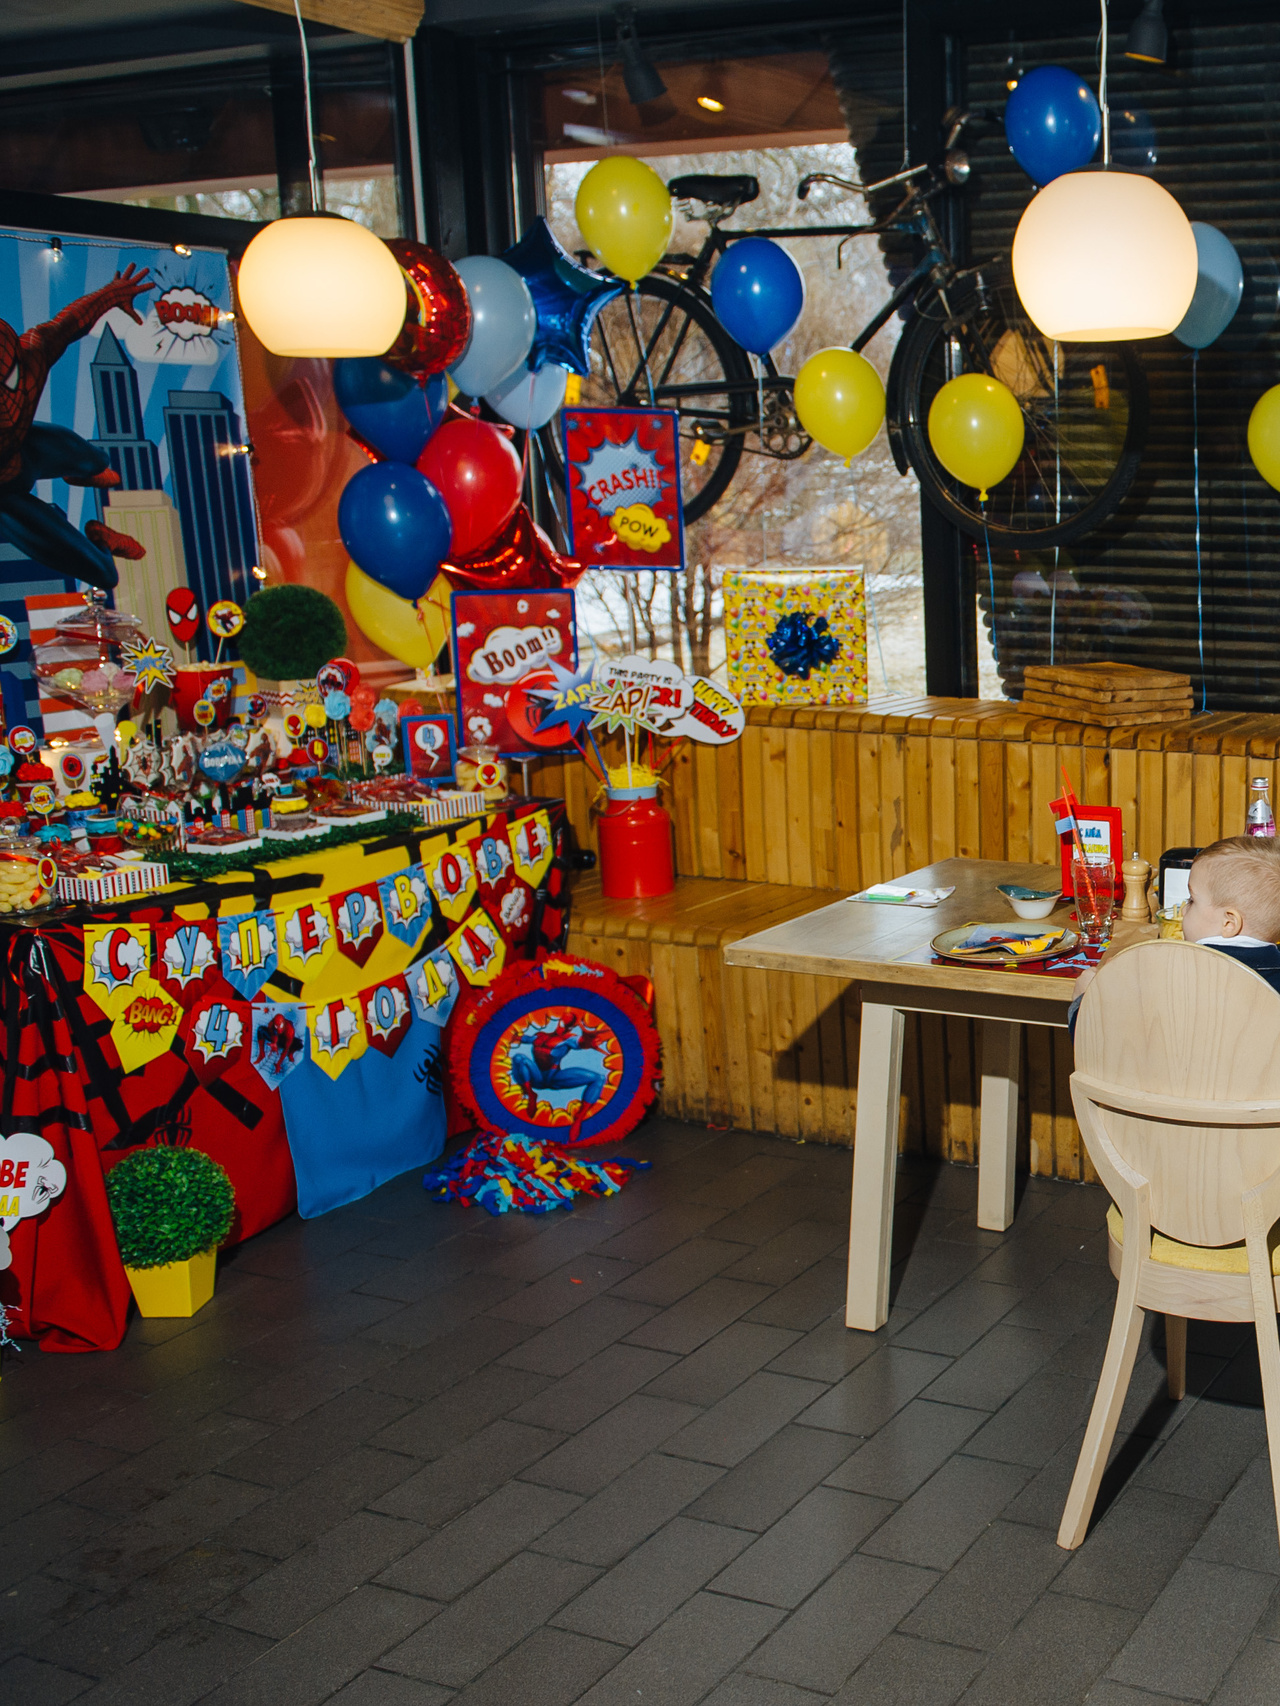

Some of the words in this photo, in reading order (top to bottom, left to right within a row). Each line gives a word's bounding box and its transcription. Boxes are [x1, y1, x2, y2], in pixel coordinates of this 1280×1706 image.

[587, 467, 662, 506] CRASH!!
[619, 516, 659, 538] POW
[609, 667, 628, 678] THIS
[631, 671, 662, 683] PARTY
[664, 676, 673, 685] IS
[592, 685, 650, 718] ZAP!
[692, 678, 739, 716] HAPPY
[422, 726, 436, 749] 4
[128, 1001, 180, 1027] BANG!
[204, 1003, 230, 1053] 4
[0, 1159, 30, 1189] ВЕ
